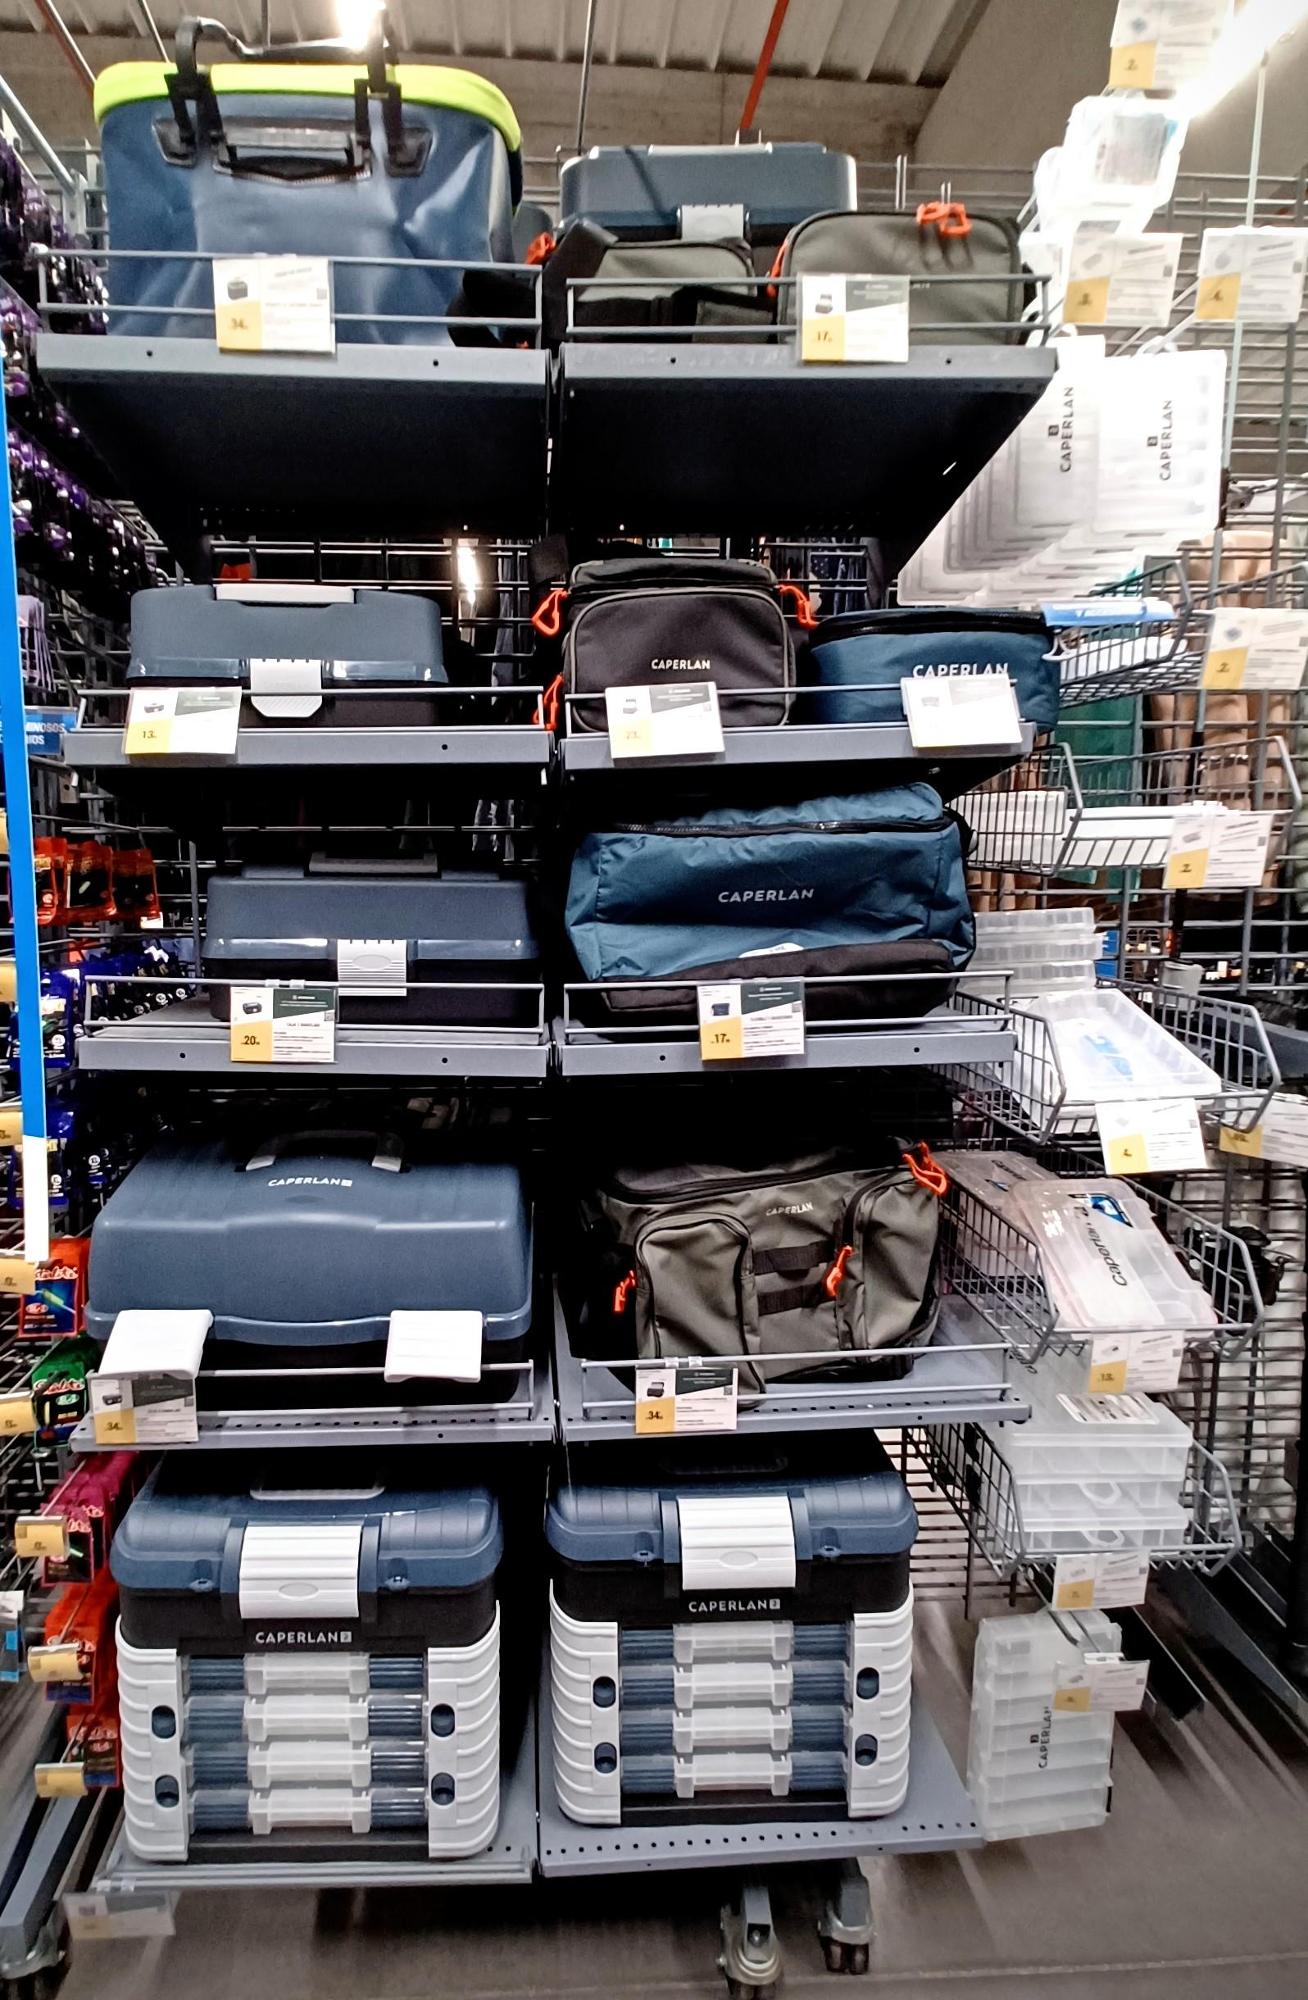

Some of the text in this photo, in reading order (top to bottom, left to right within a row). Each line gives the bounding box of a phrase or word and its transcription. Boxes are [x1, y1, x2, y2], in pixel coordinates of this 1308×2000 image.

[1060, 387, 1074, 473] CAPERLAN
[1159, 400, 1173, 481] CAPERLAN
[651, 659, 711, 670] CAPERLAN
[718, 888, 815, 903] CAPERLAN
[268, 1177, 341, 1187] CAPERLAN
[765, 1201, 814, 1216] CAPERLAN
[688, 1599, 768, 1613] CAPERLAN
[255, 1631, 338, 1644] CAPERLAN
